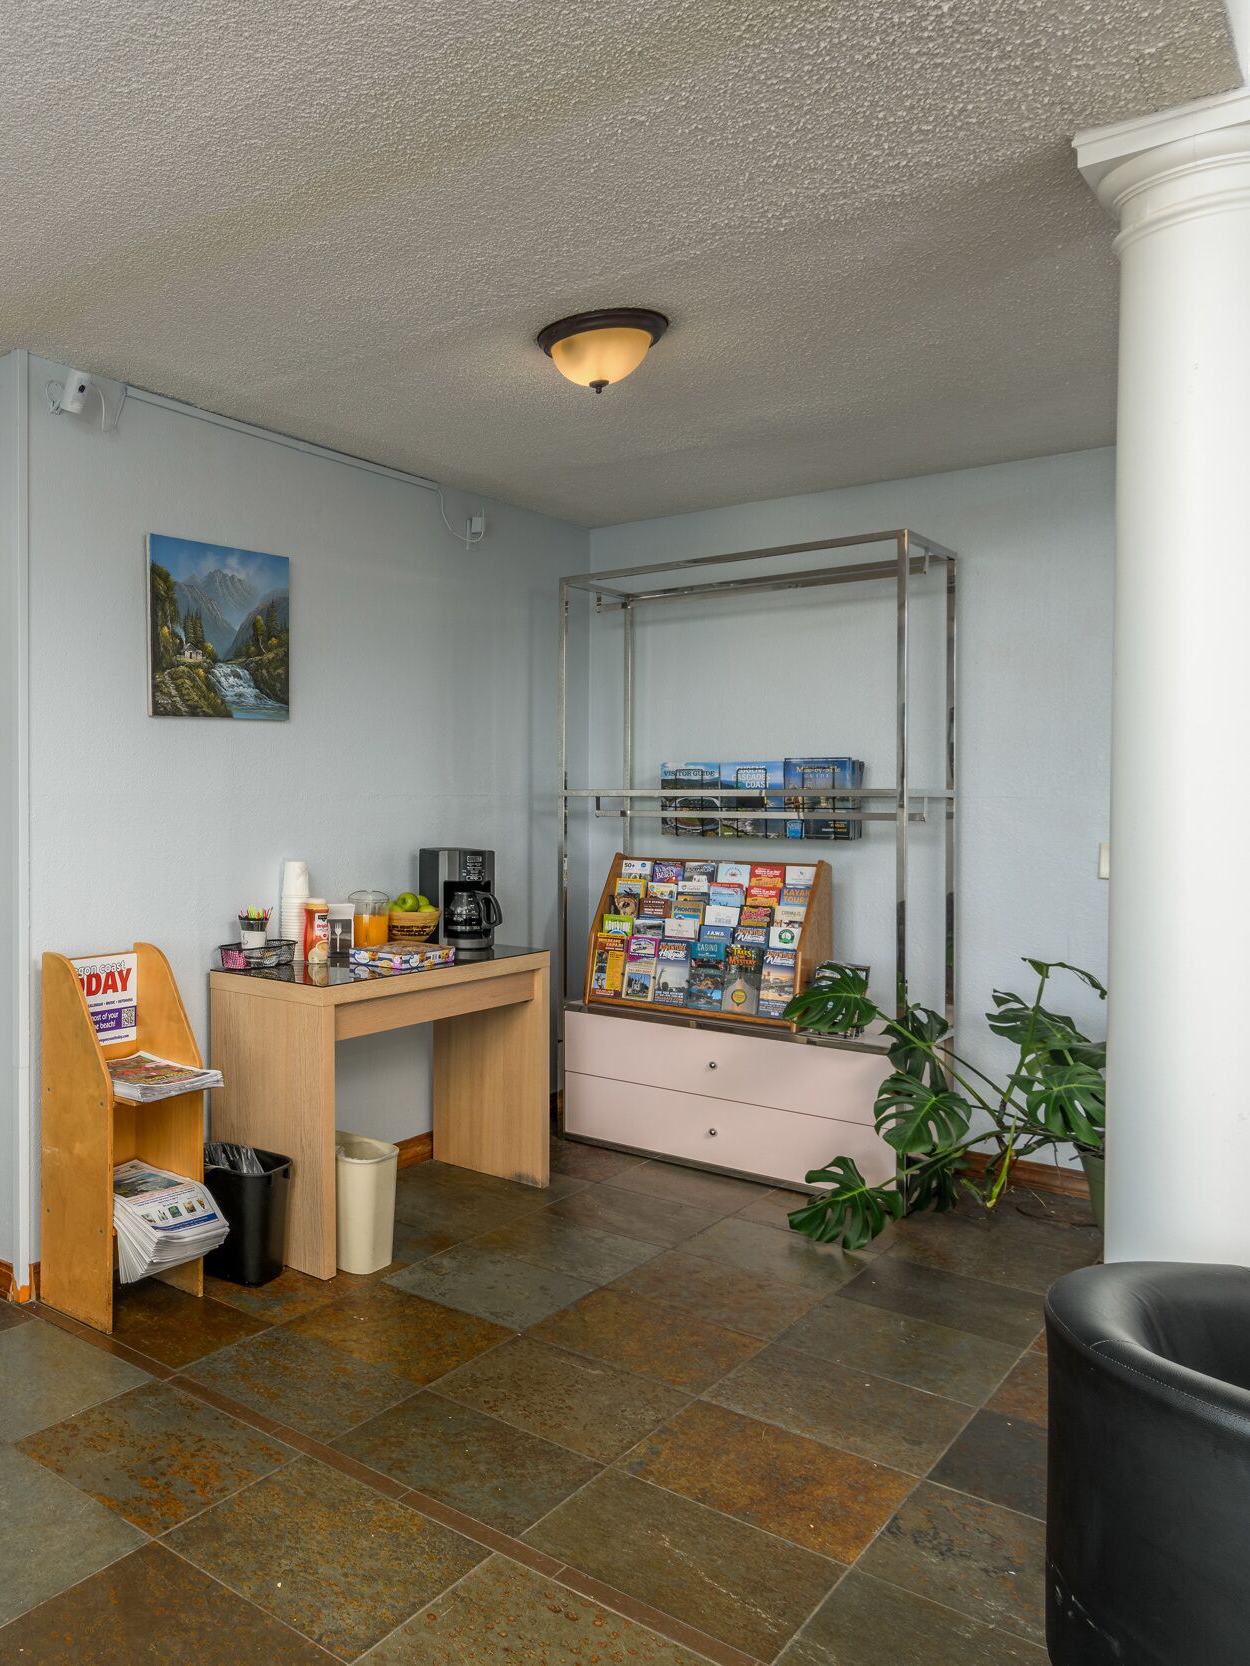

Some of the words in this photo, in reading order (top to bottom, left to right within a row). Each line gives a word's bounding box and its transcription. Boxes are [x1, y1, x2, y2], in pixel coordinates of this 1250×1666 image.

[693, 769, 715, 777] GUIDE
[731, 774, 771, 782] CASCADES
[697, 943, 718, 952] CASINO
[99, 960, 126, 974] coast
[101, 1012, 108, 1020] of
[108, 1012, 119, 1020] your
[100, 1020, 116, 1029] beach!
